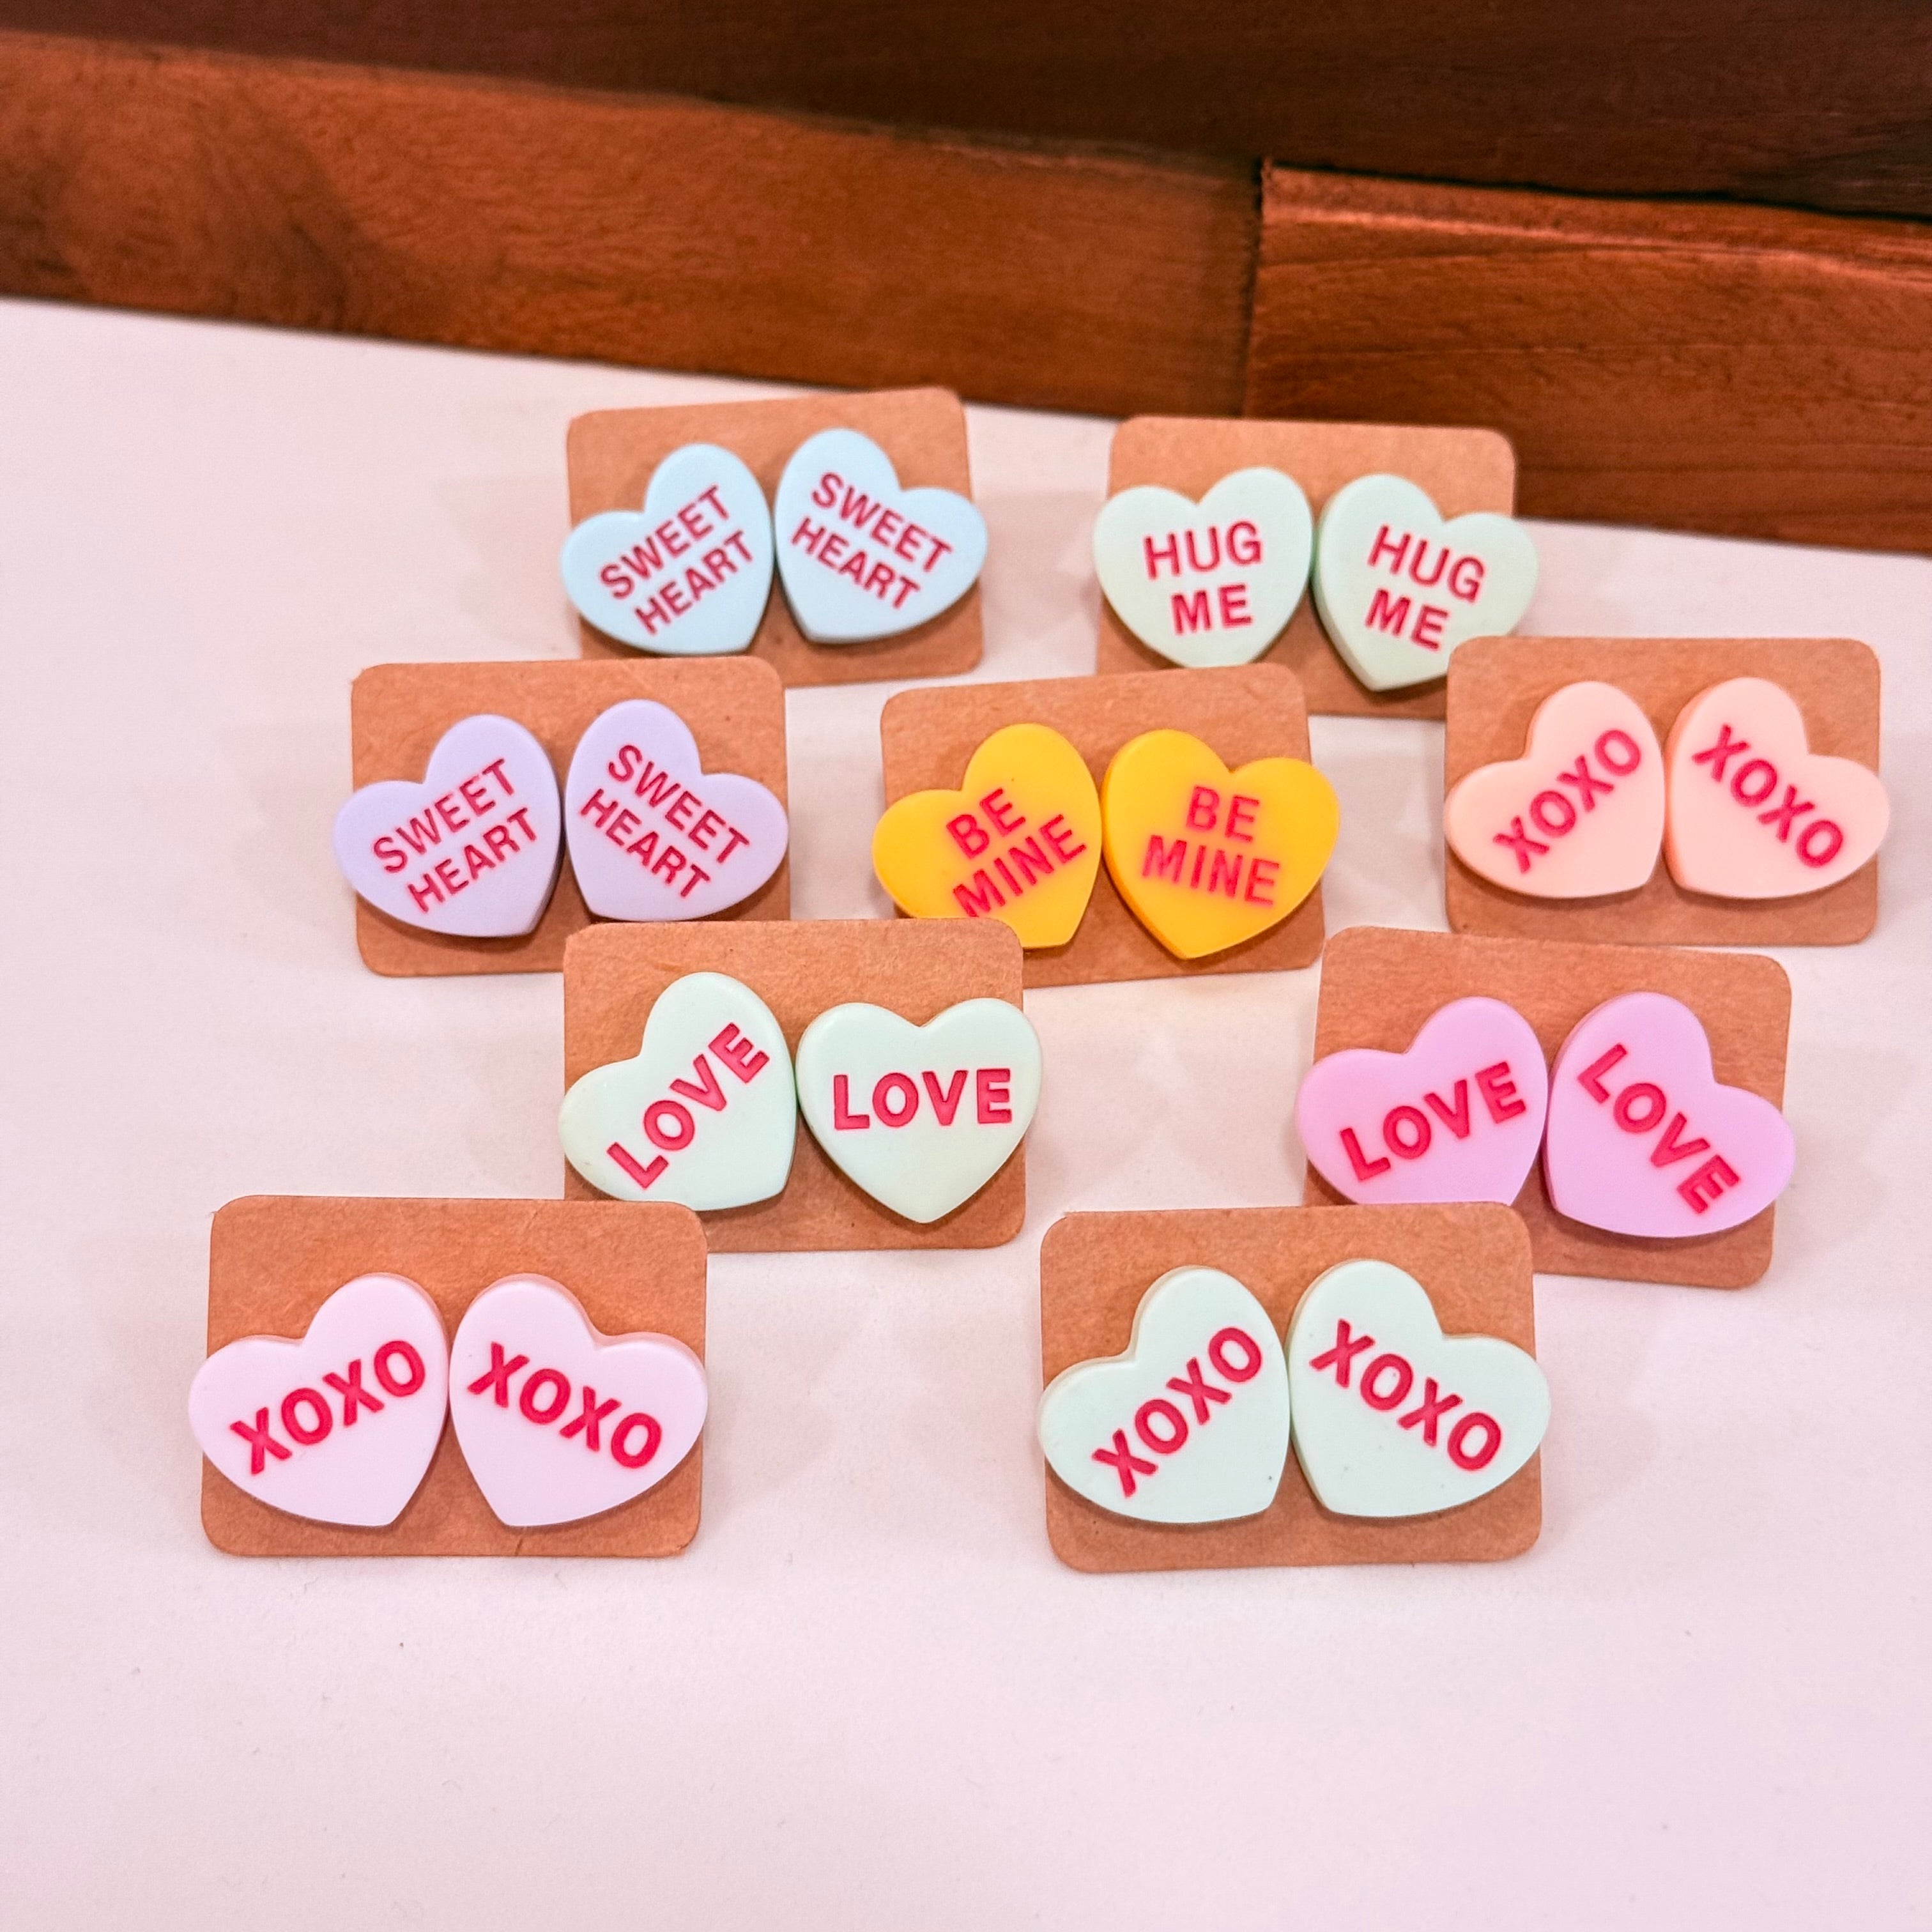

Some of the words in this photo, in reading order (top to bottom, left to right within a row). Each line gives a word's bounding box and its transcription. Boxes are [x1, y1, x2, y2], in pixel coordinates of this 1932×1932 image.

[599, 484, 730, 601] SWEET
[791, 517, 919, 610] HEART
[811, 471, 953, 572] SWEET
[1143, 520, 1262, 580] HUG
[1367, 524, 1486, 603] HUG
[634, 529, 753, 635] HEART
[1170, 583, 1253, 636] ME
[1365, 588, 1450, 651] ME
[372, 758, 516, 873] SWEET
[579, 788, 711, 898] HEART
[607, 744, 749, 864] SWEET
[946, 786, 1026, 860] BE
[1186, 785, 1261, 844] BE
[1493, 728, 1642, 874] XOXO
[1692, 724, 1844, 868] XOXO
[406, 806, 539, 914] HEART
[952, 814, 1087, 917] MINE
[1142, 834, 1280, 907] MINE
[606, 1022, 770, 1190] LOVE
[833, 1068, 1013, 1130] LOVE
[1340, 1061, 1526, 1182] LOVE
[1577, 1043, 1740, 1215] LOVE
[230, 1340, 426, 1476] XOXO
[467, 1341, 663, 1469] XOXO
[1092, 1326, 1263, 1498] XOXO
[1309, 1319, 1502, 1471] XOXO
